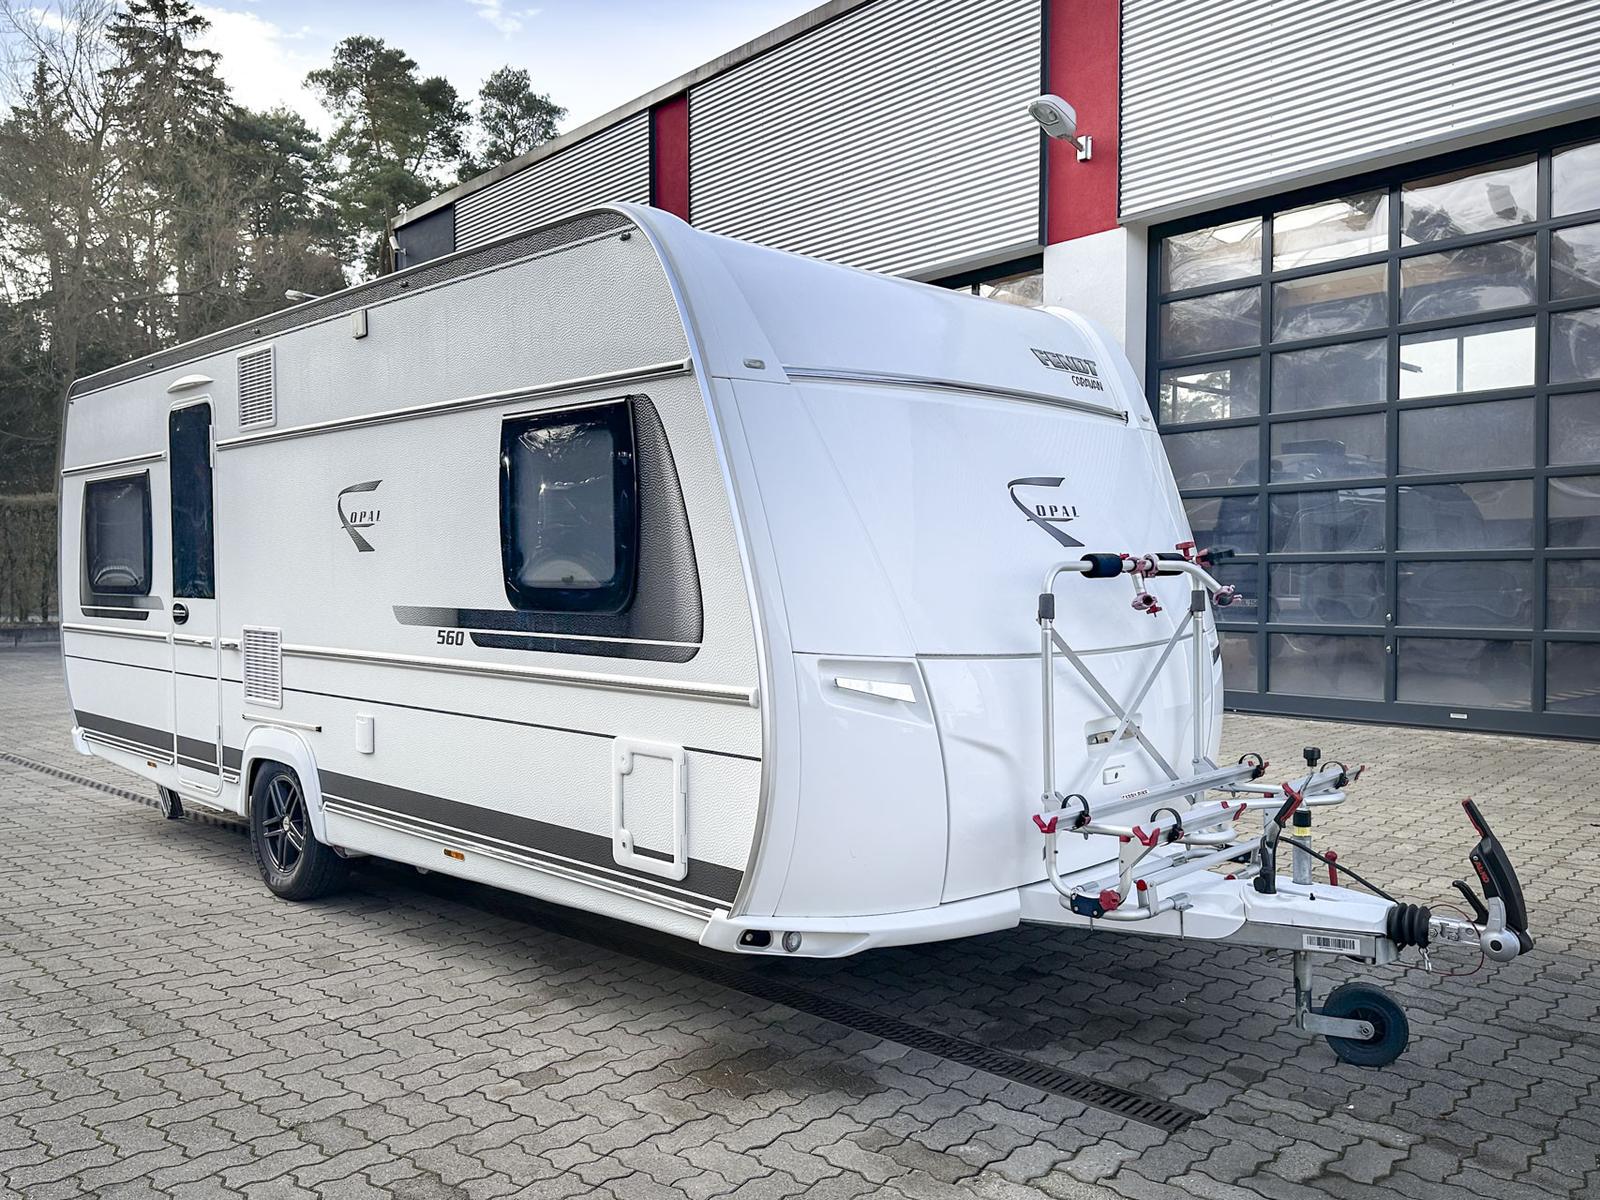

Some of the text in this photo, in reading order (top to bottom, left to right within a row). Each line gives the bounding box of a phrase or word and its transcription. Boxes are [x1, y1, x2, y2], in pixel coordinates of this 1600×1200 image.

[1030, 347, 1098, 377] FENDT
[1071, 375, 1104, 392] CARAVAN
[350, 510, 381, 523] OPAL
[1035, 504, 1080, 517] OPAL
[436, 629, 465, 646] 560
